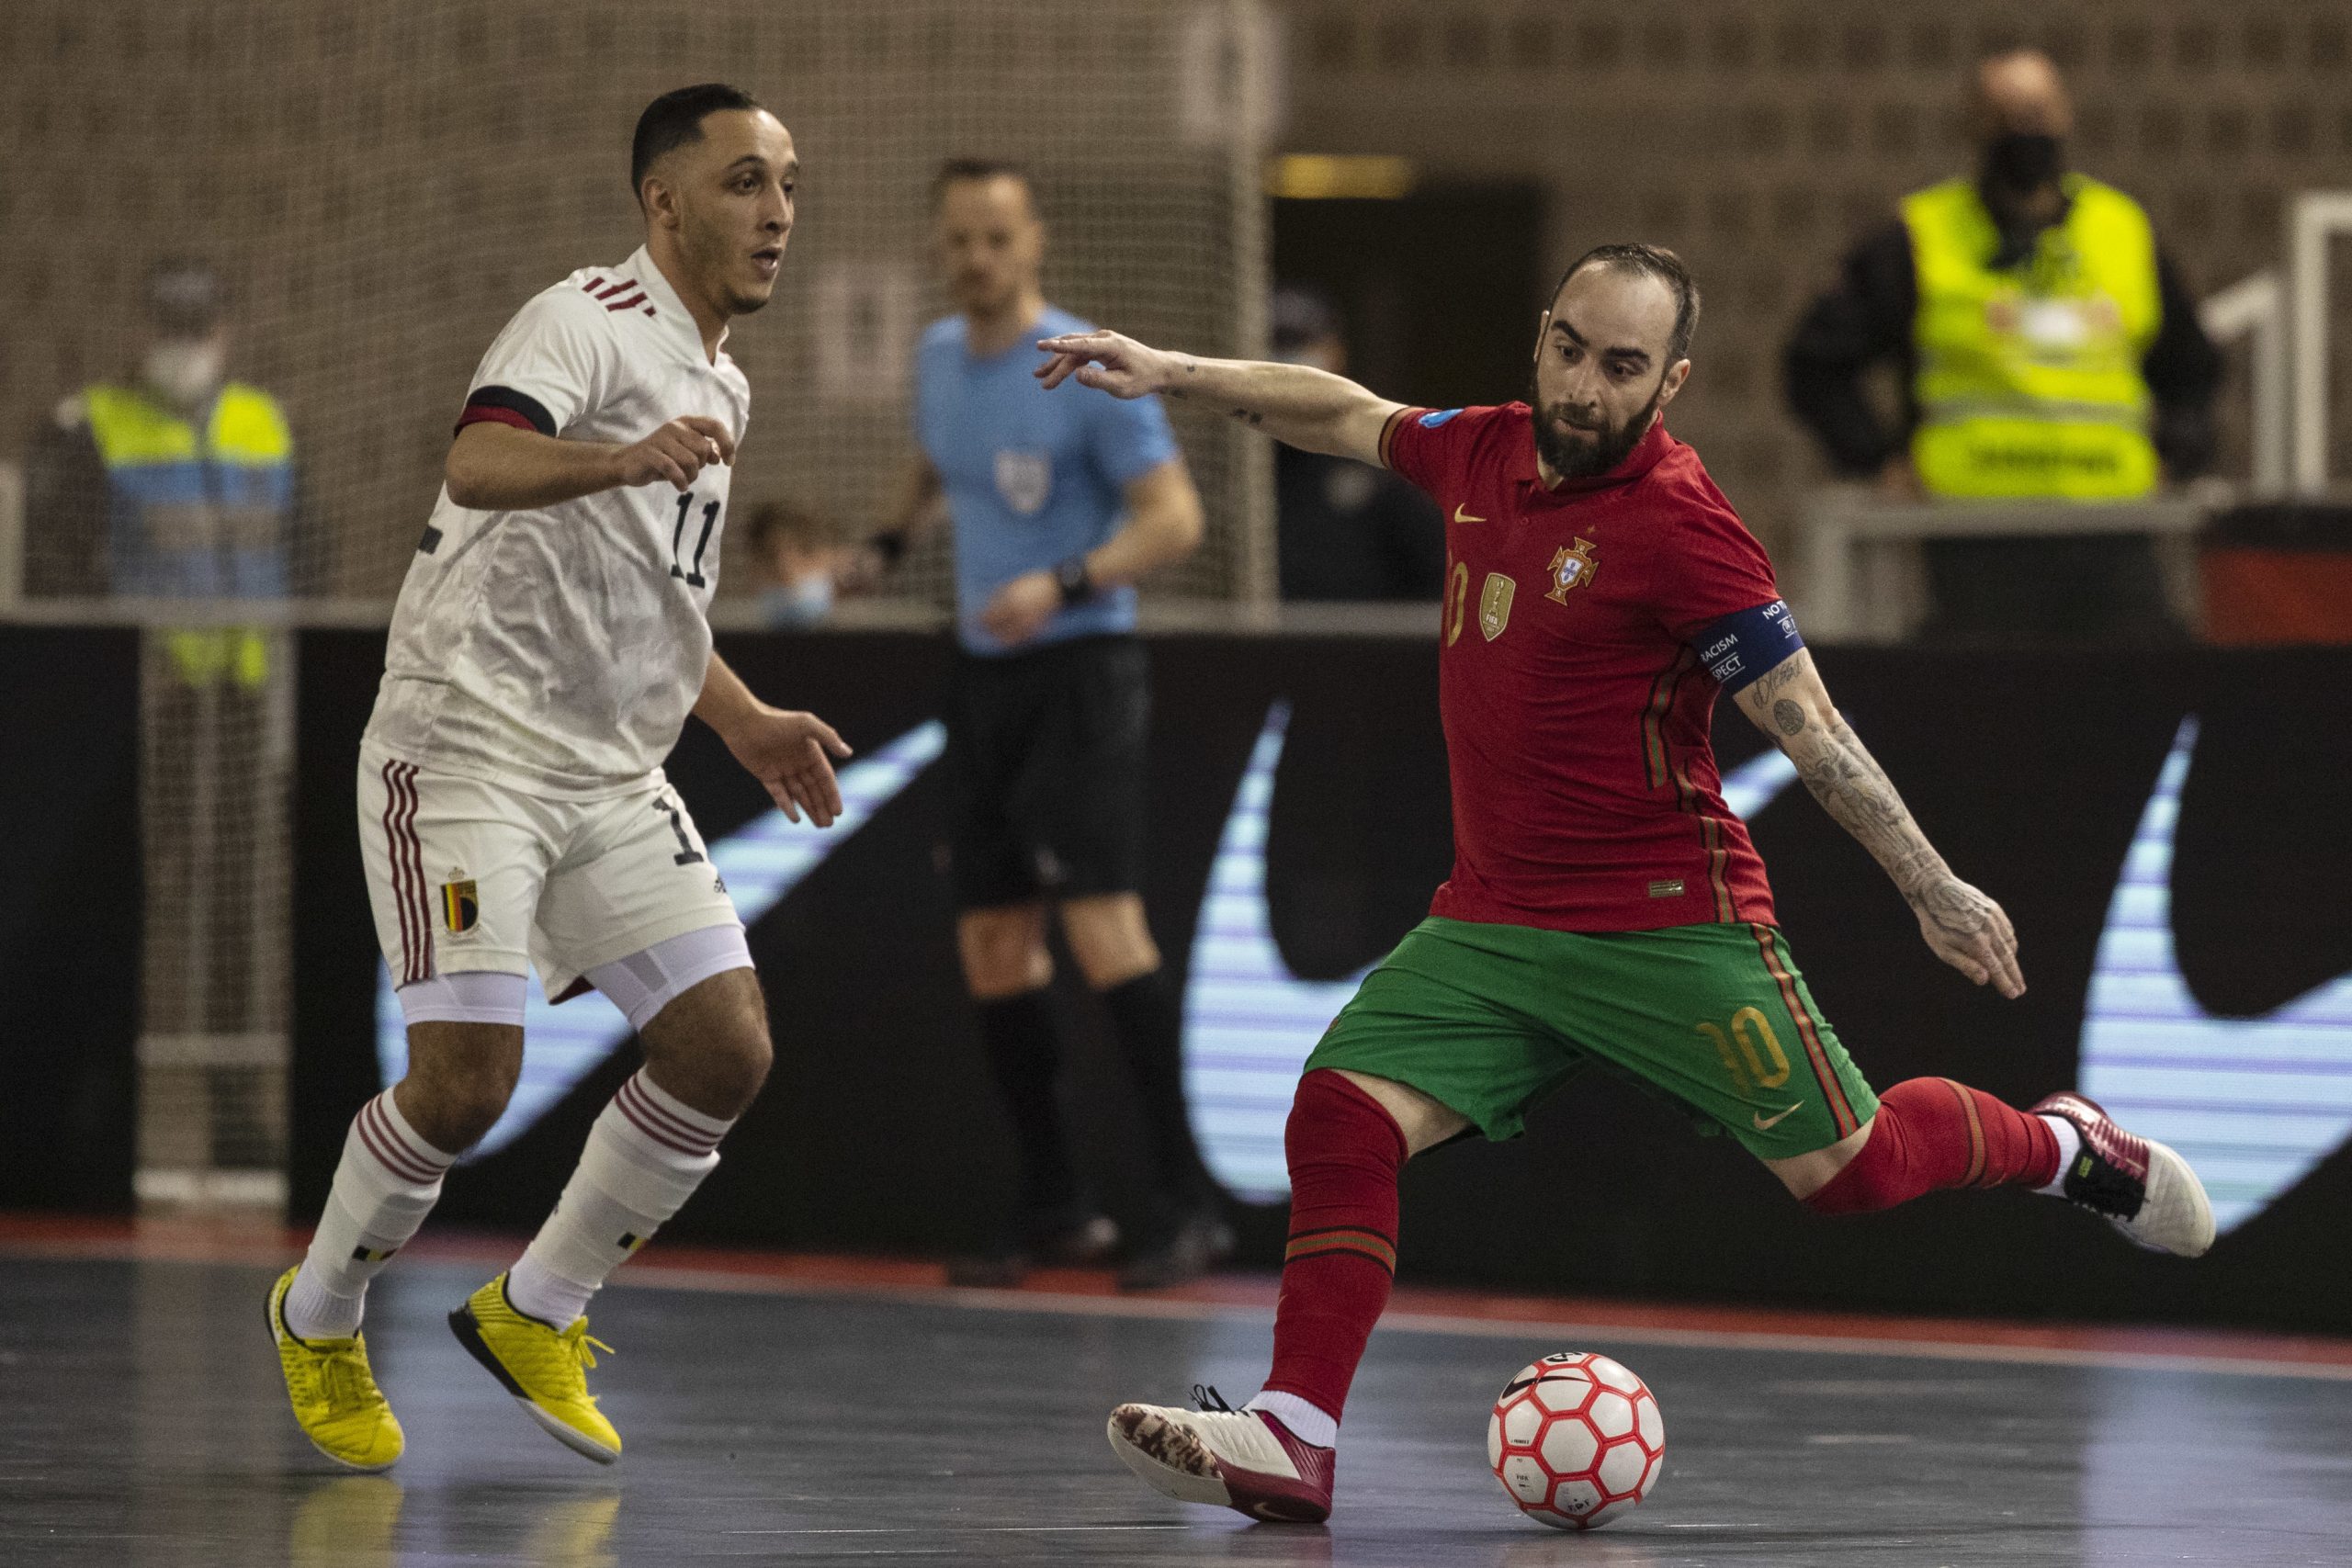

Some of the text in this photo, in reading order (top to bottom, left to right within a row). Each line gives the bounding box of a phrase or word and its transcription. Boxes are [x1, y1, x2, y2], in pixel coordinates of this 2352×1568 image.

[670, 491, 720, 589] 11
[1445, 549, 1468, 647] 0
[1695, 1007, 1790, 1100] 10
